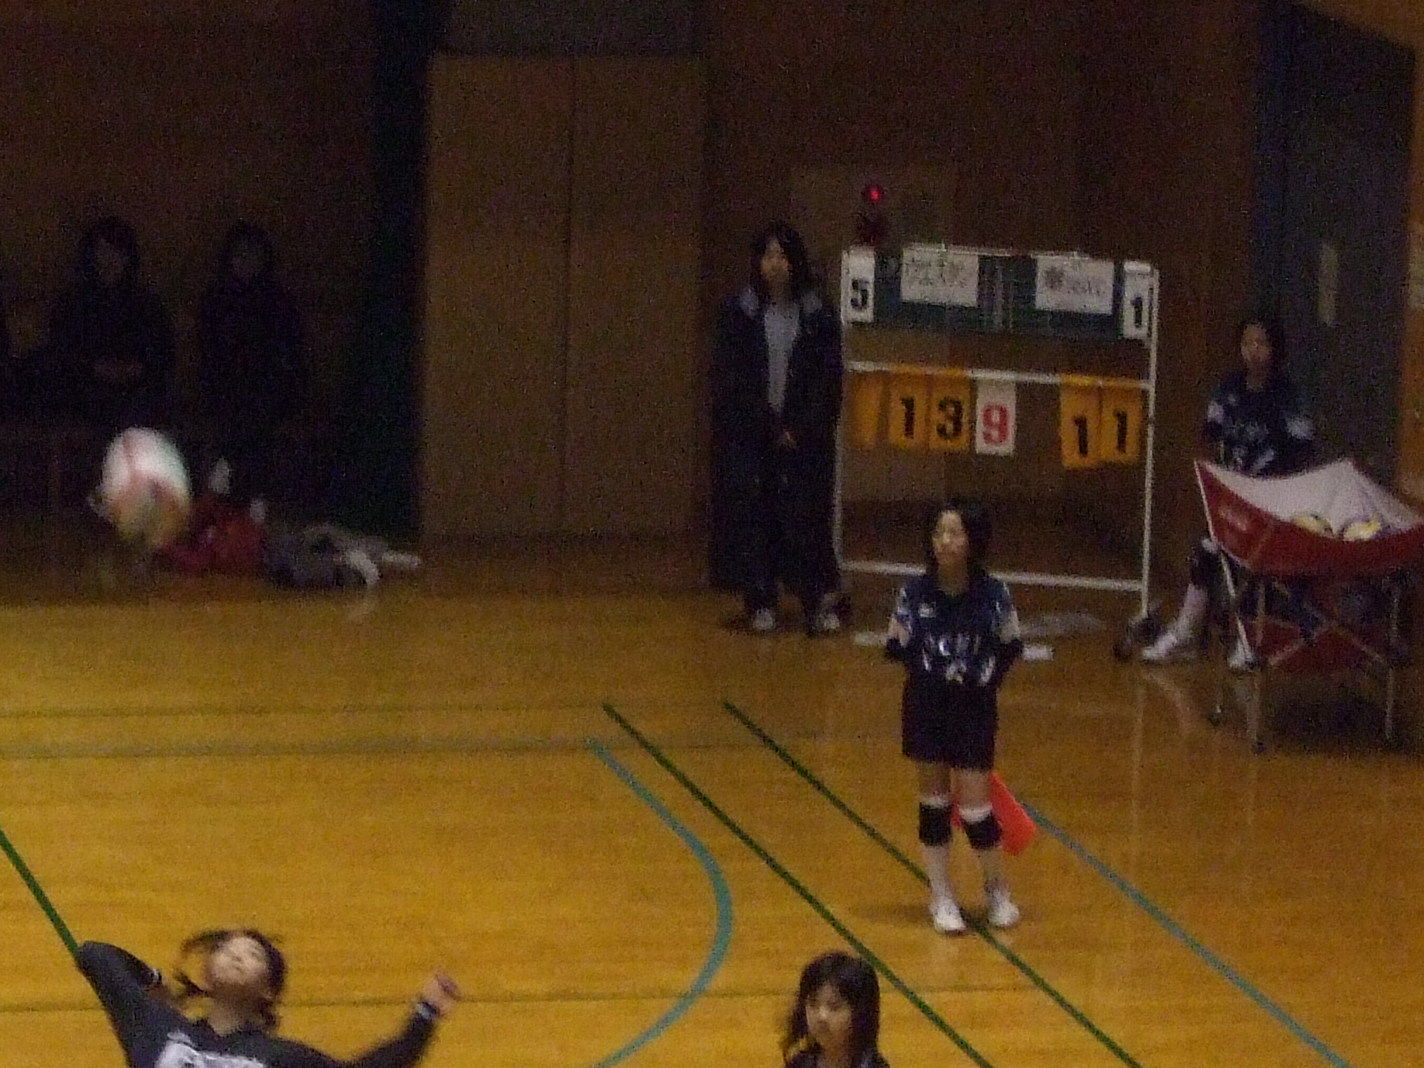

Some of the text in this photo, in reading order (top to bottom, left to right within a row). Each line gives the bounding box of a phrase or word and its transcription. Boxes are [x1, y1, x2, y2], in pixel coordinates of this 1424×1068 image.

[851, 278, 869, 310] 5
[1130, 297, 1143, 328] 1
[983, 405, 1009, 445] 9
